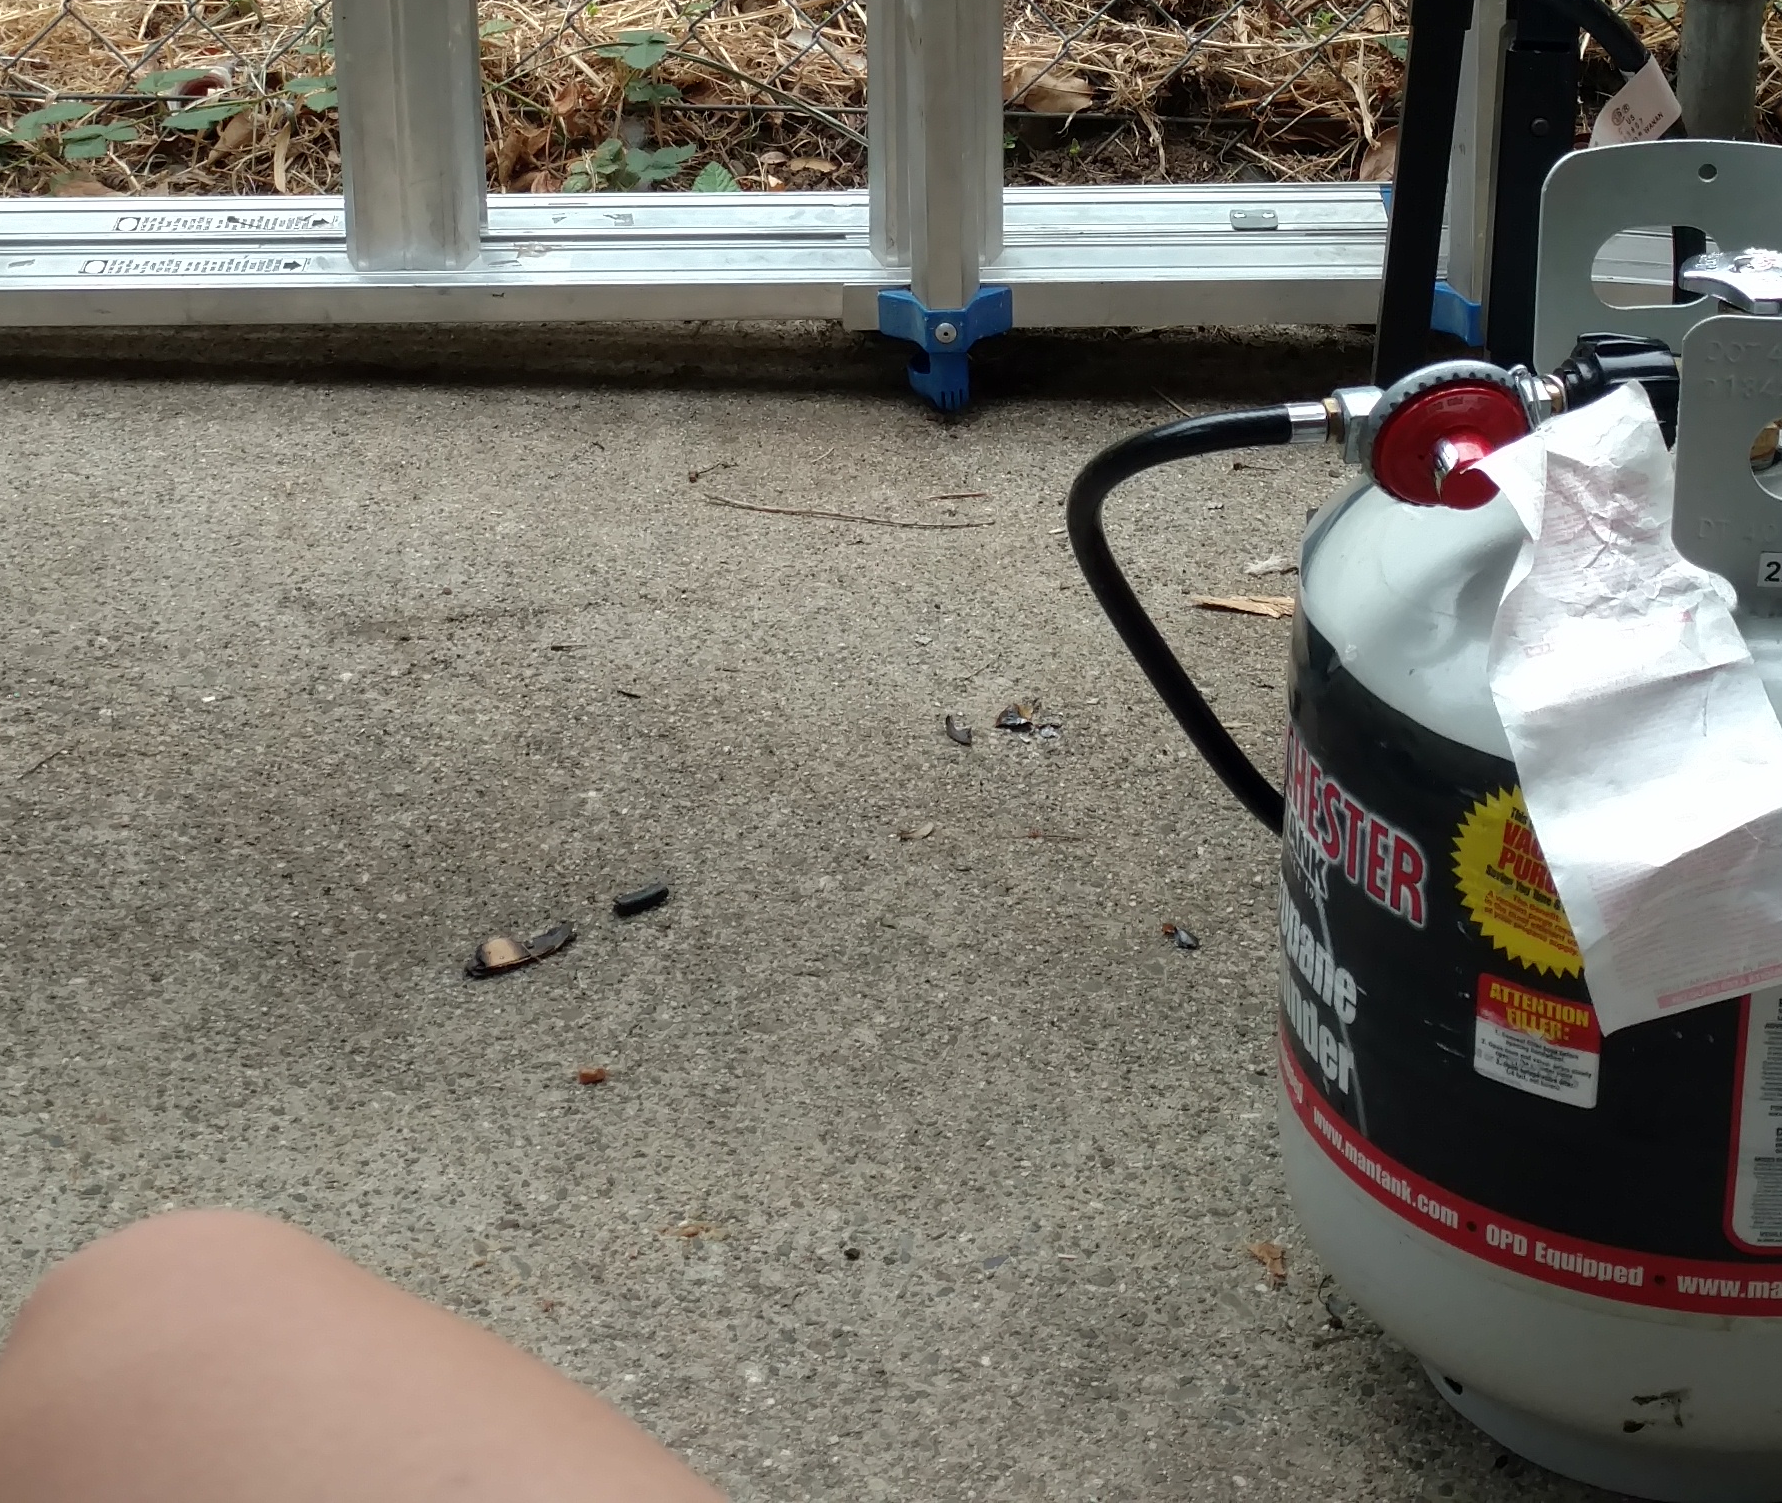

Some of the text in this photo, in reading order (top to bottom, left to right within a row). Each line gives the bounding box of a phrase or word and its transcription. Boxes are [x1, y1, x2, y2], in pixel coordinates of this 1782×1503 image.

[1489, 982, 1590, 1028] ATTENTION
[1505, 1006, 1570, 1041] FILLER:
[1312, 1105, 1459, 1230] www.mantank.com
[1486, 1223, 1644, 1287] OPD Equipped
